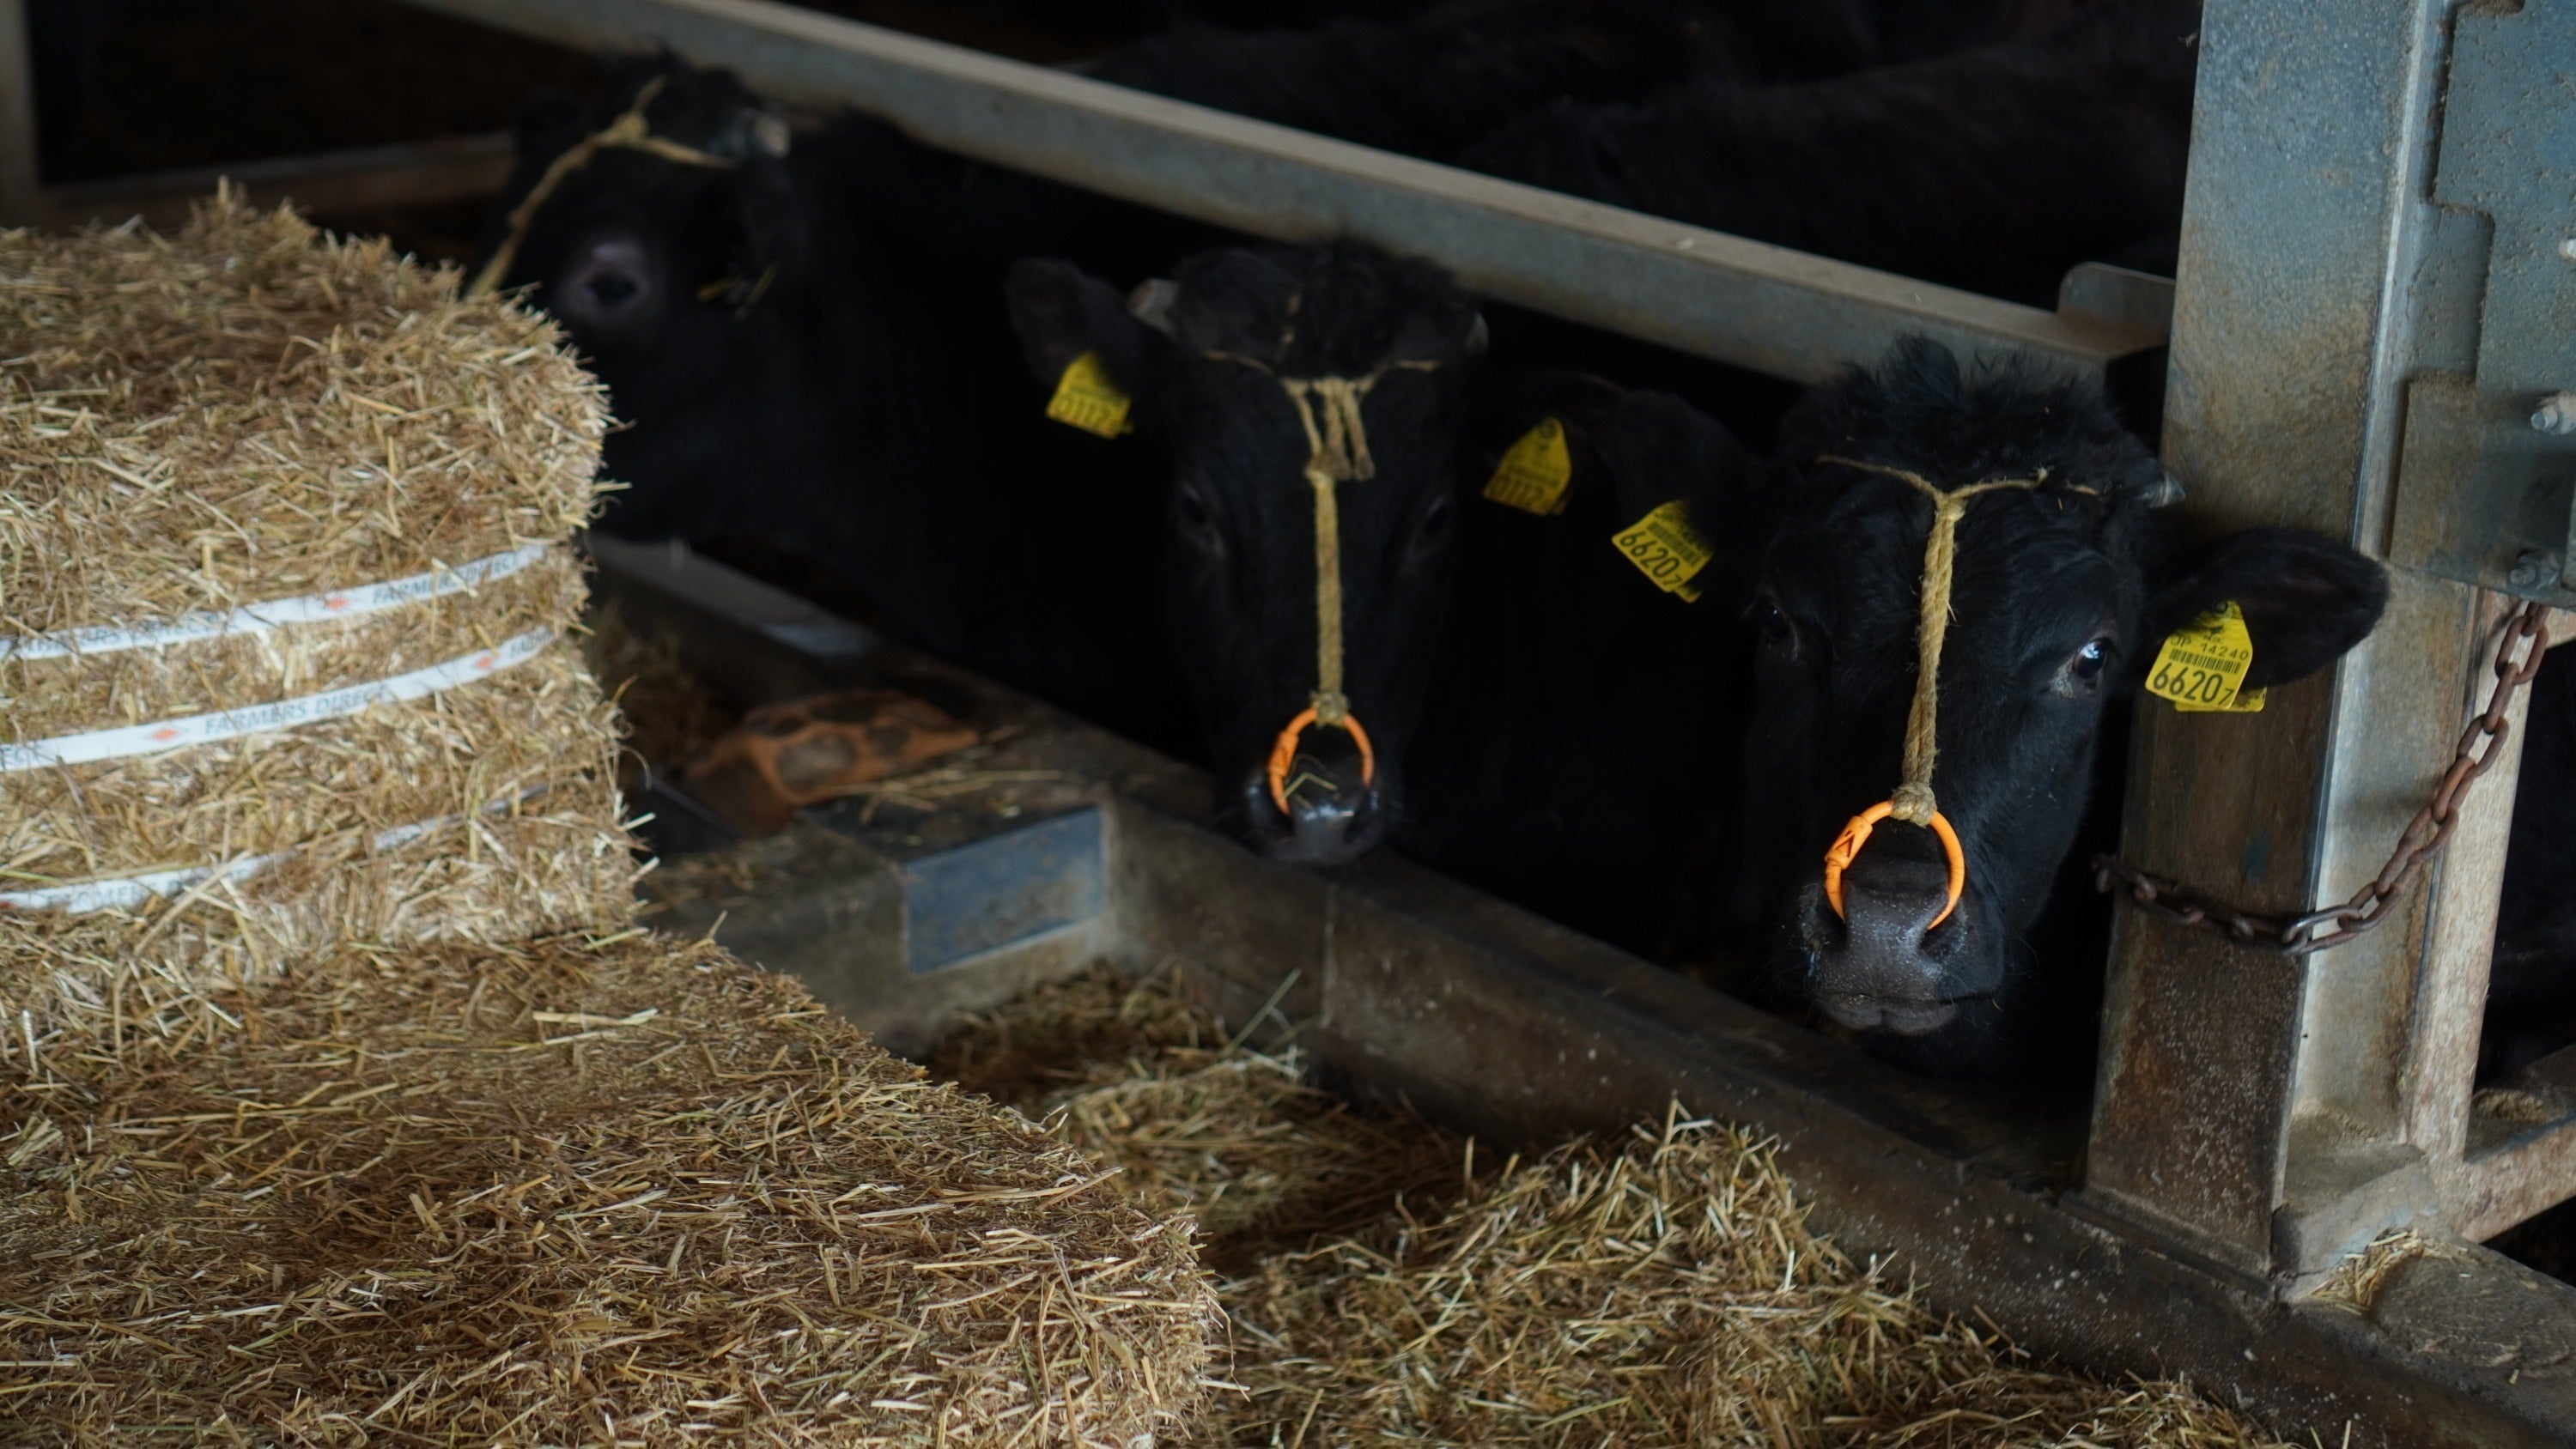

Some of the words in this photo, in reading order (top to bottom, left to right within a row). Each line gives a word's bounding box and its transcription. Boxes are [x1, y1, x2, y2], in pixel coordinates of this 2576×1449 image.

[1619, 530, 1684, 585] 66207
[2200, 643, 2250, 661] 14240
[2153, 663, 2235, 706] 66207
[204, 700, 307, 736] FARMERS
